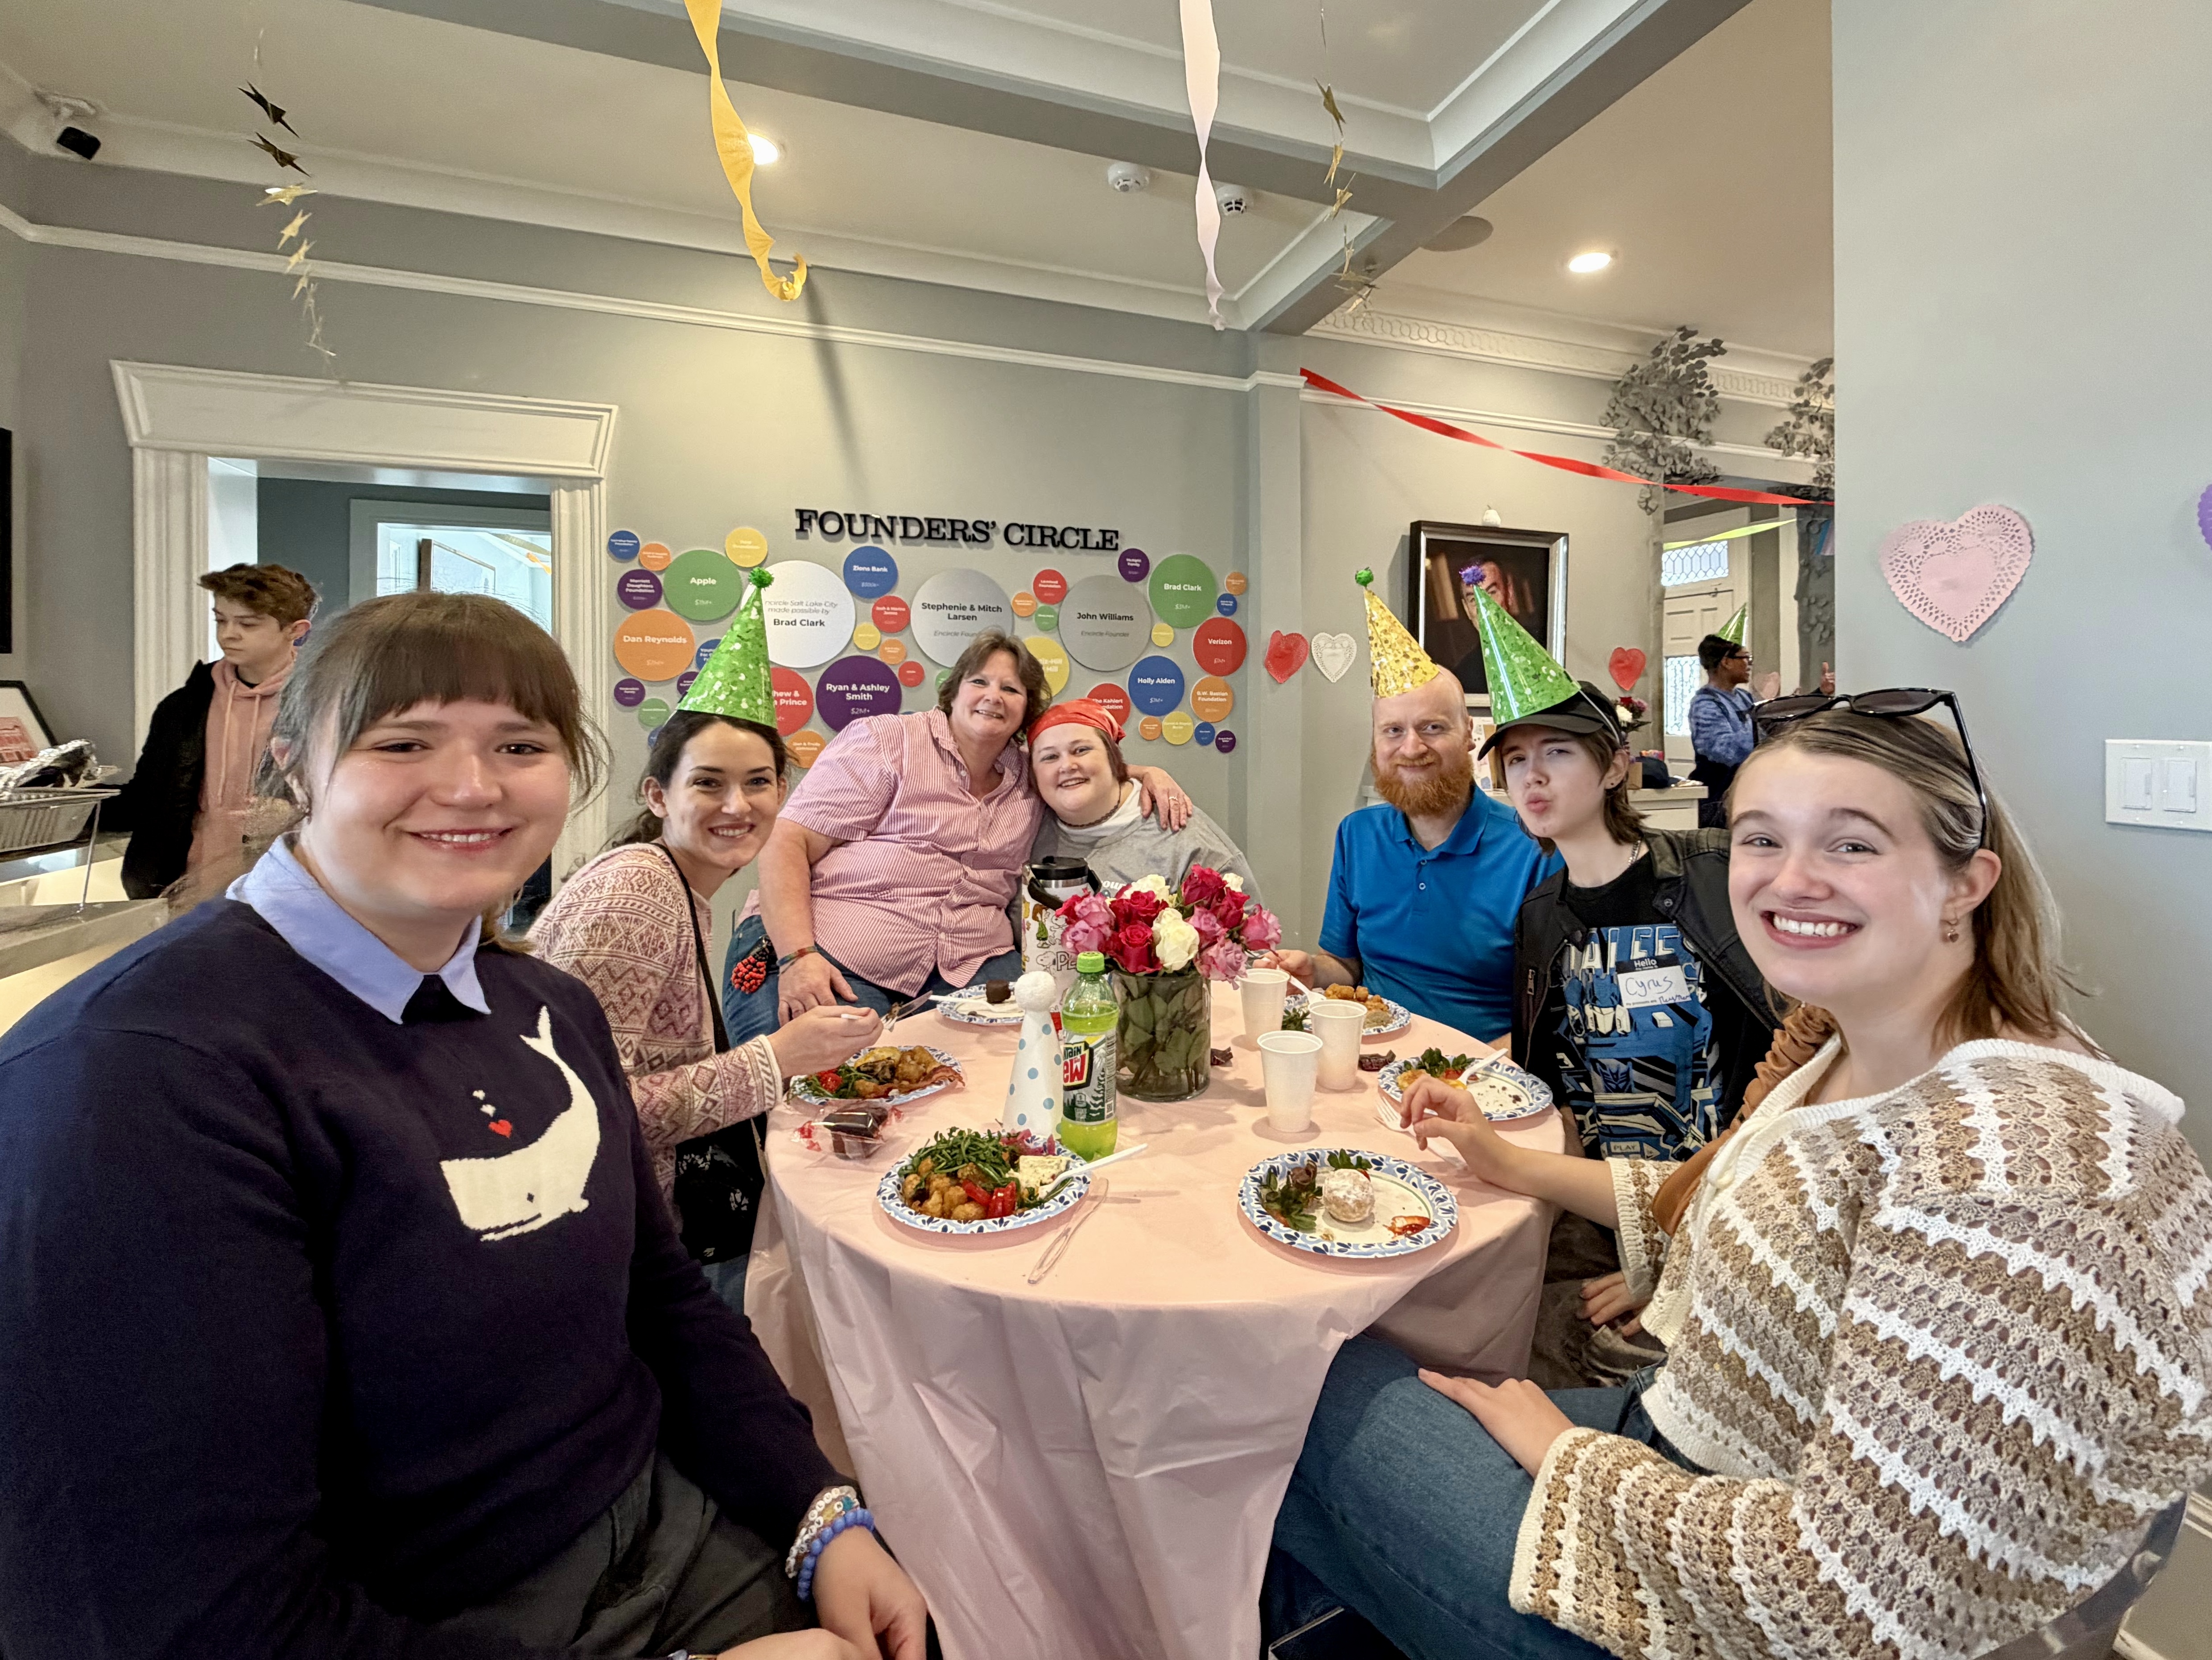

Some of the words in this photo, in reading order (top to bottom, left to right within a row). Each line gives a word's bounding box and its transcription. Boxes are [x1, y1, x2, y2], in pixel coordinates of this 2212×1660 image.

[795, 509, 997, 543] FOUNDERS'
[1004, 523, 1119, 551] CIRCLE
[690, 577, 717, 586] Apple
[1183, 584, 1202, 592] Clark
[921, 602, 967, 612] Stephenie
[978, 605, 1002, 613] Mitch
[1077, 612, 1097, 621] John
[1099, 613, 1134, 621] Williams
[799, 619, 825, 627] Clark
[645, 635, 687, 644] Reynolds
[826, 684, 849, 692] Ryan
[859, 684, 890, 693] Ashley
[846, 693, 873, 701] Smith
[1634, 958, 1657, 968] Hello
[1626, 976, 1673, 997] Cyrus
